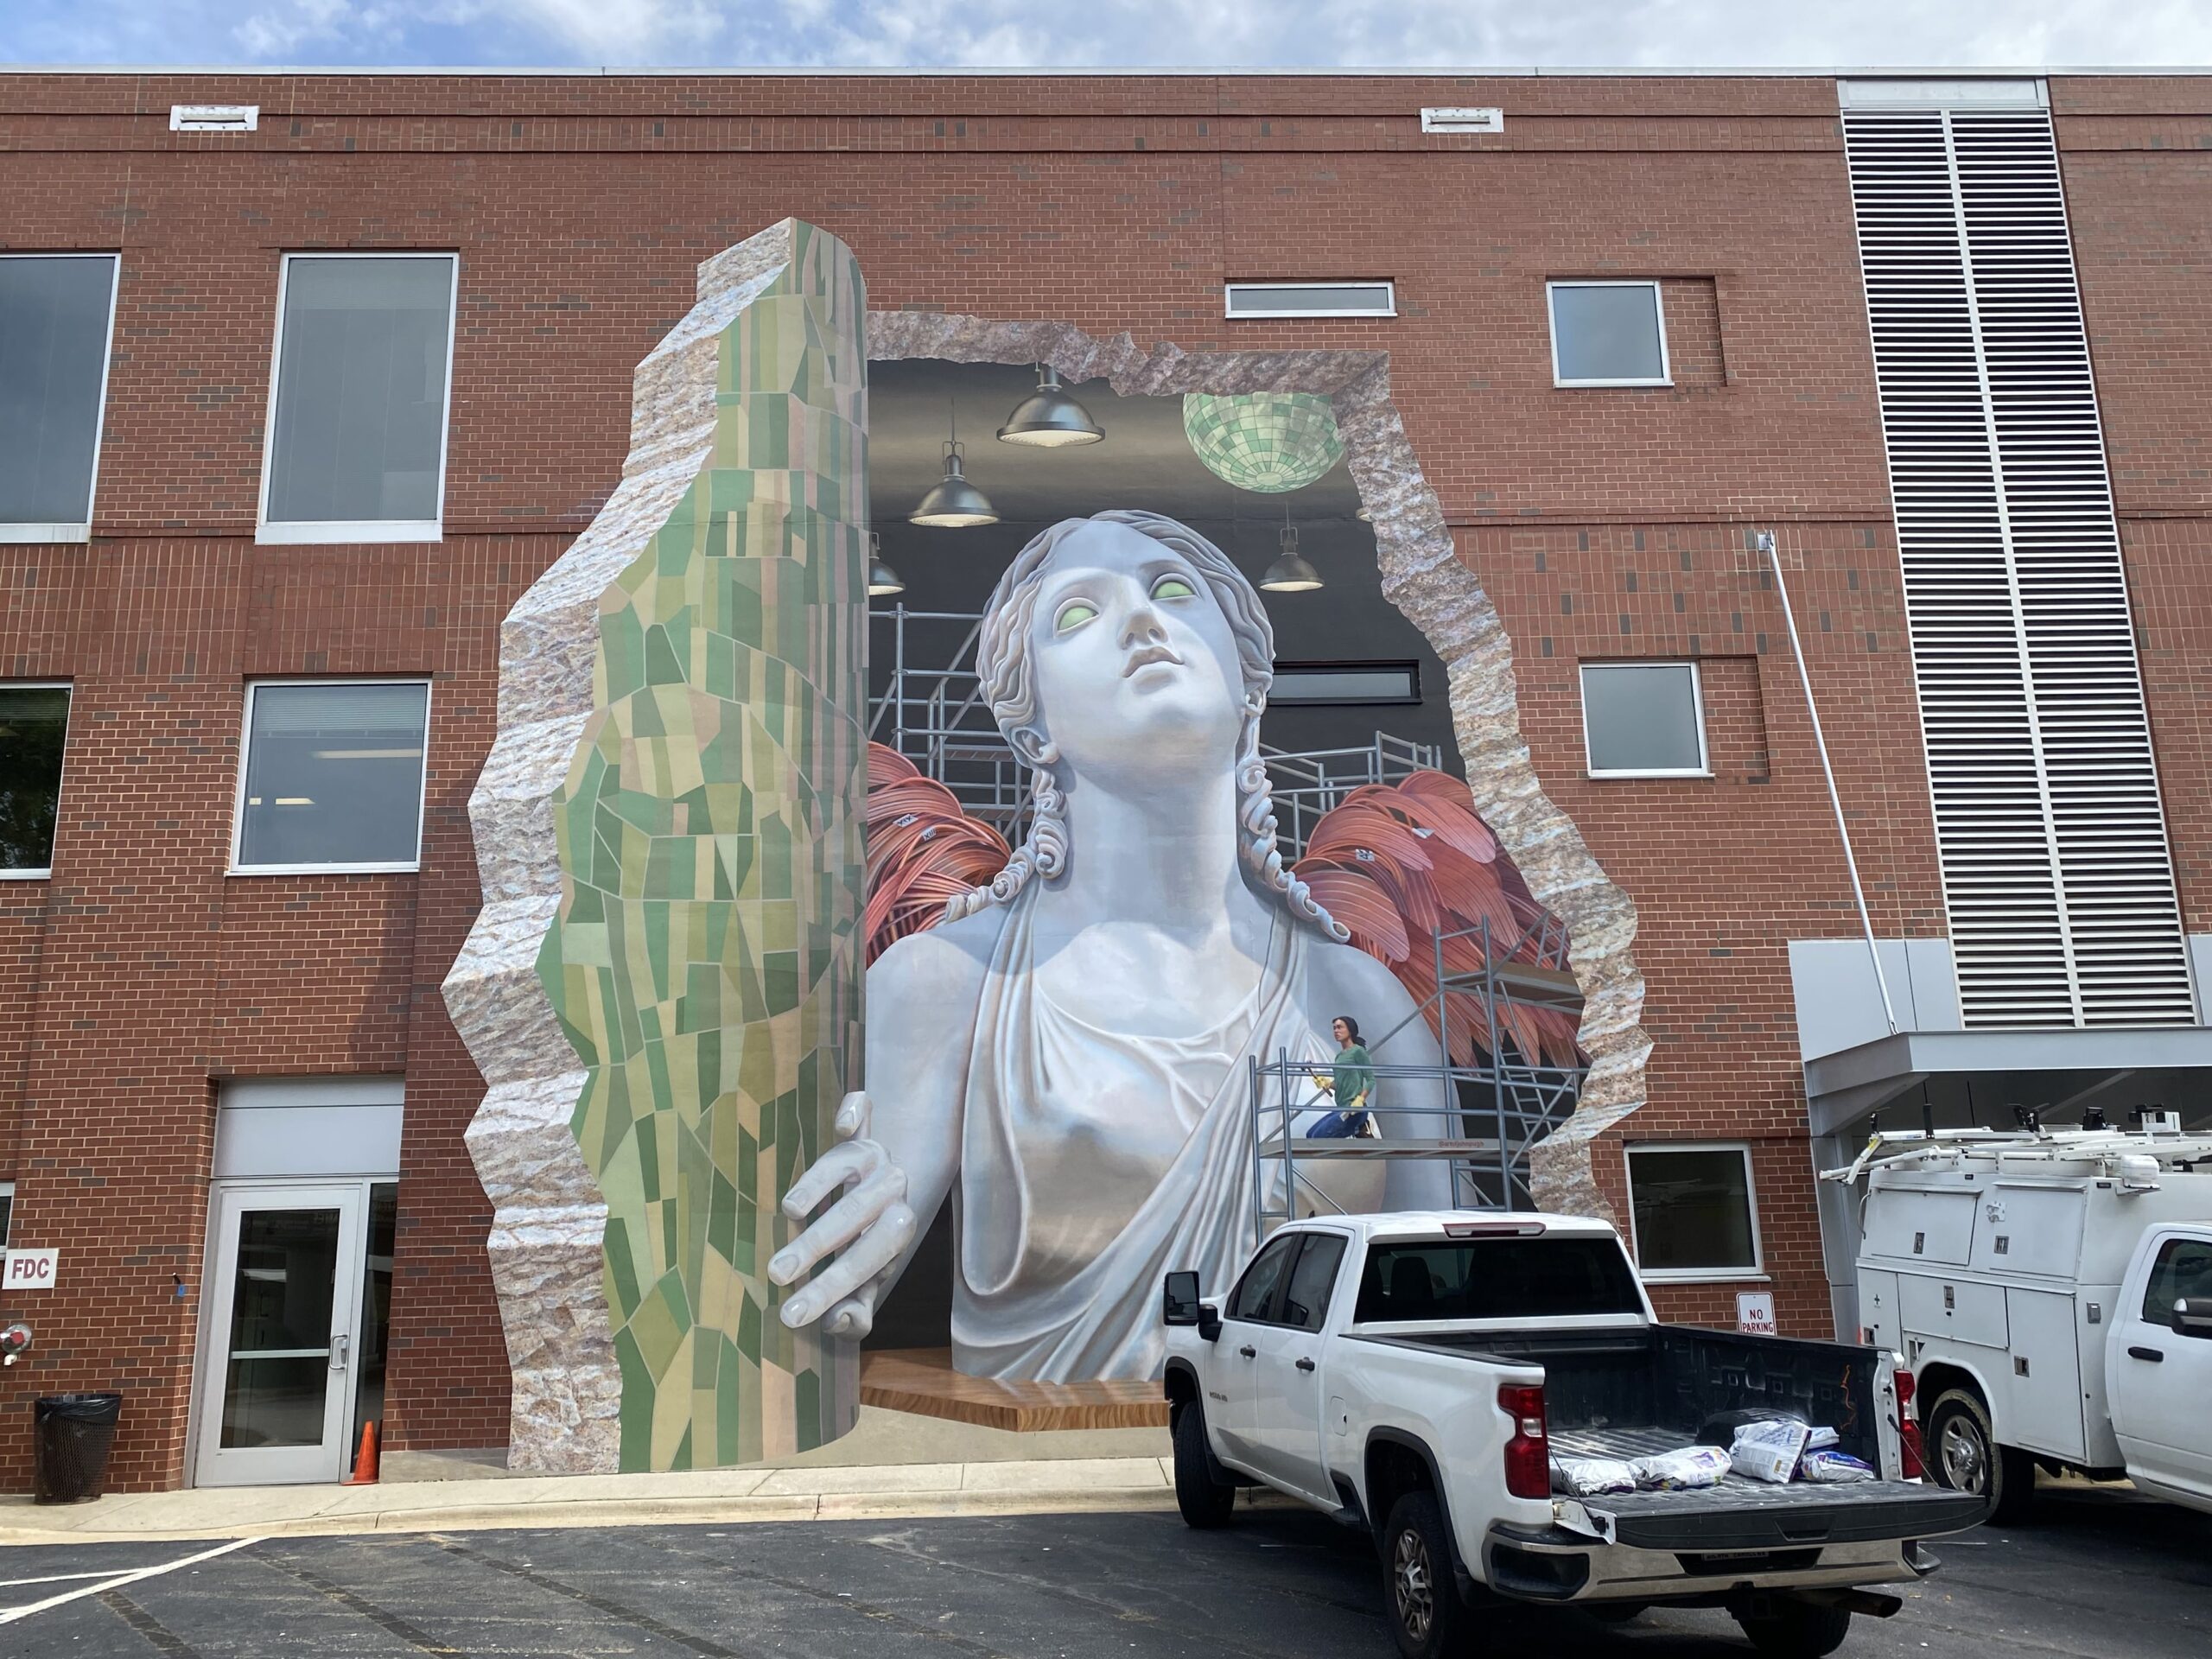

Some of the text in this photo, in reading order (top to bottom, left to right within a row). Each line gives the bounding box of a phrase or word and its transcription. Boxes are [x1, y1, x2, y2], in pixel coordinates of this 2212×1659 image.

[11, 1257, 49, 1279] FDC
[1750, 1309, 1764, 1319] NO
[1742, 1322, 1773, 1333] PARKING
